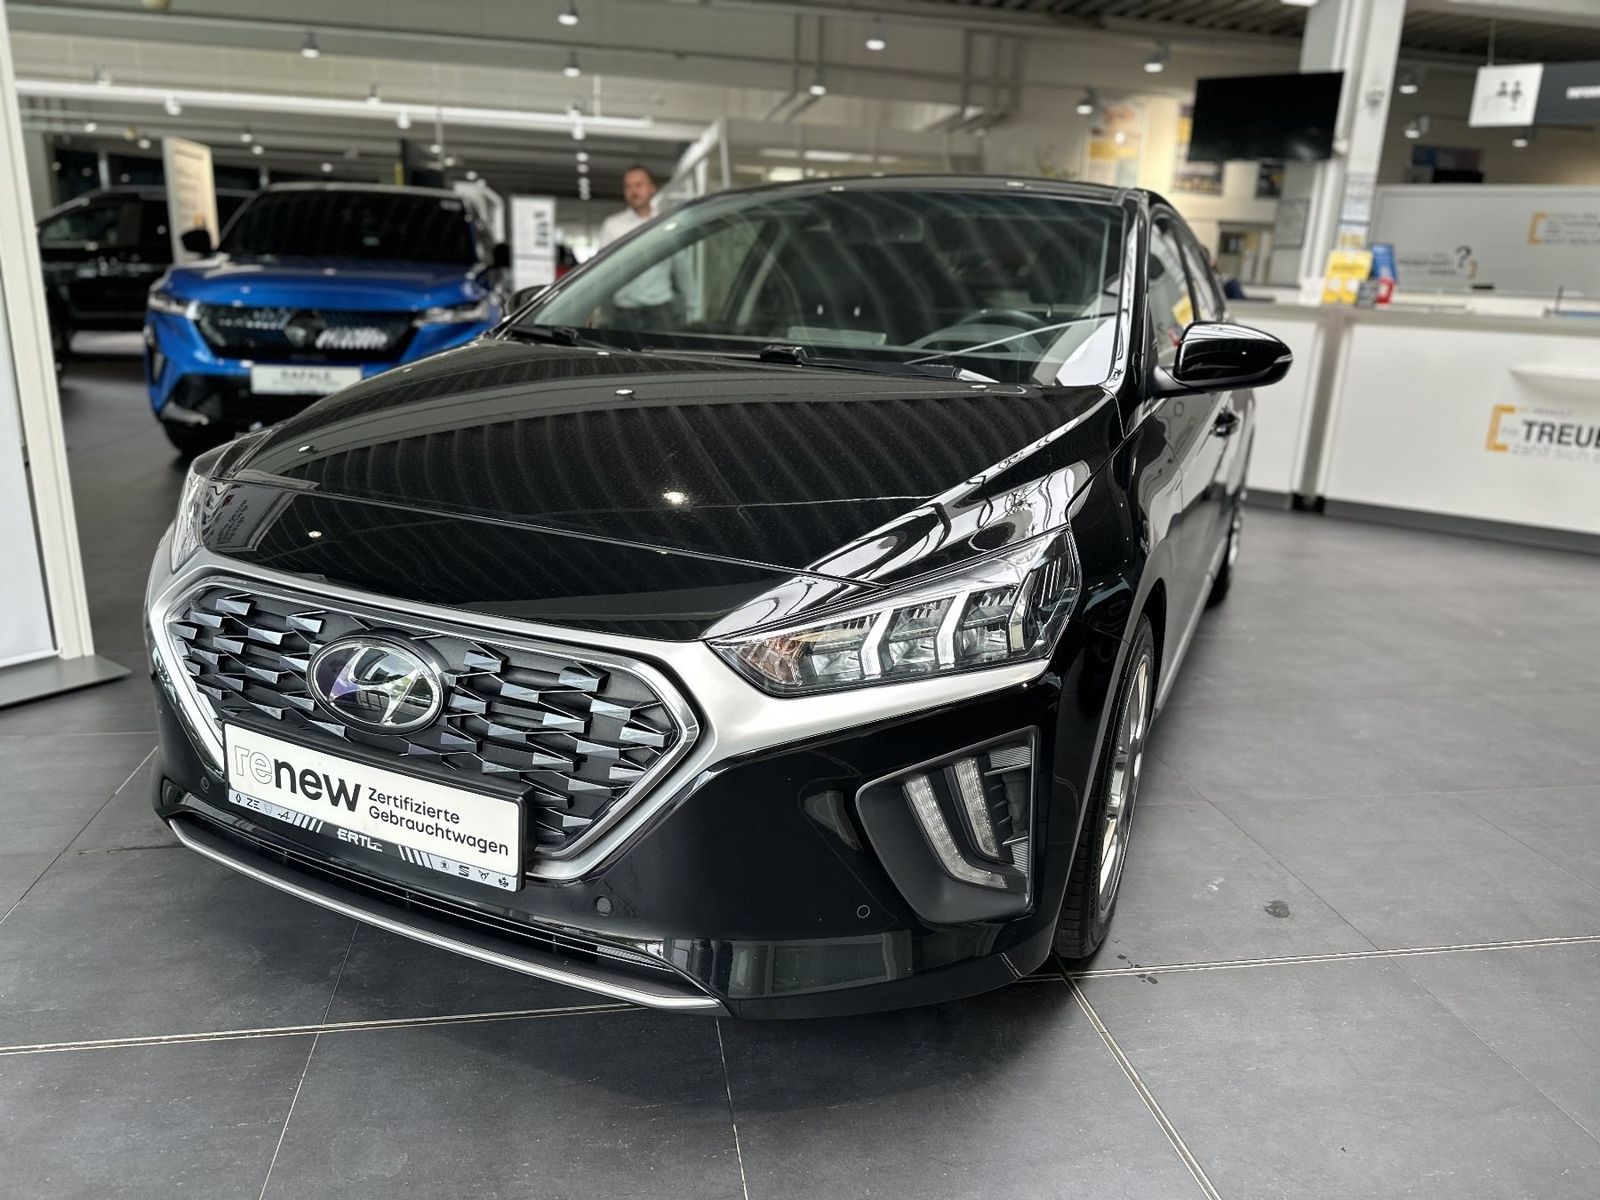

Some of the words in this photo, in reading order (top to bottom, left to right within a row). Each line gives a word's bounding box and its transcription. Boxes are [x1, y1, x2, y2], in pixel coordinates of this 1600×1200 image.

[234, 744, 361, 812] renew
[368, 787, 460, 824] Zertifizierte
[369, 805, 509, 856] Gebrauchtwagen
